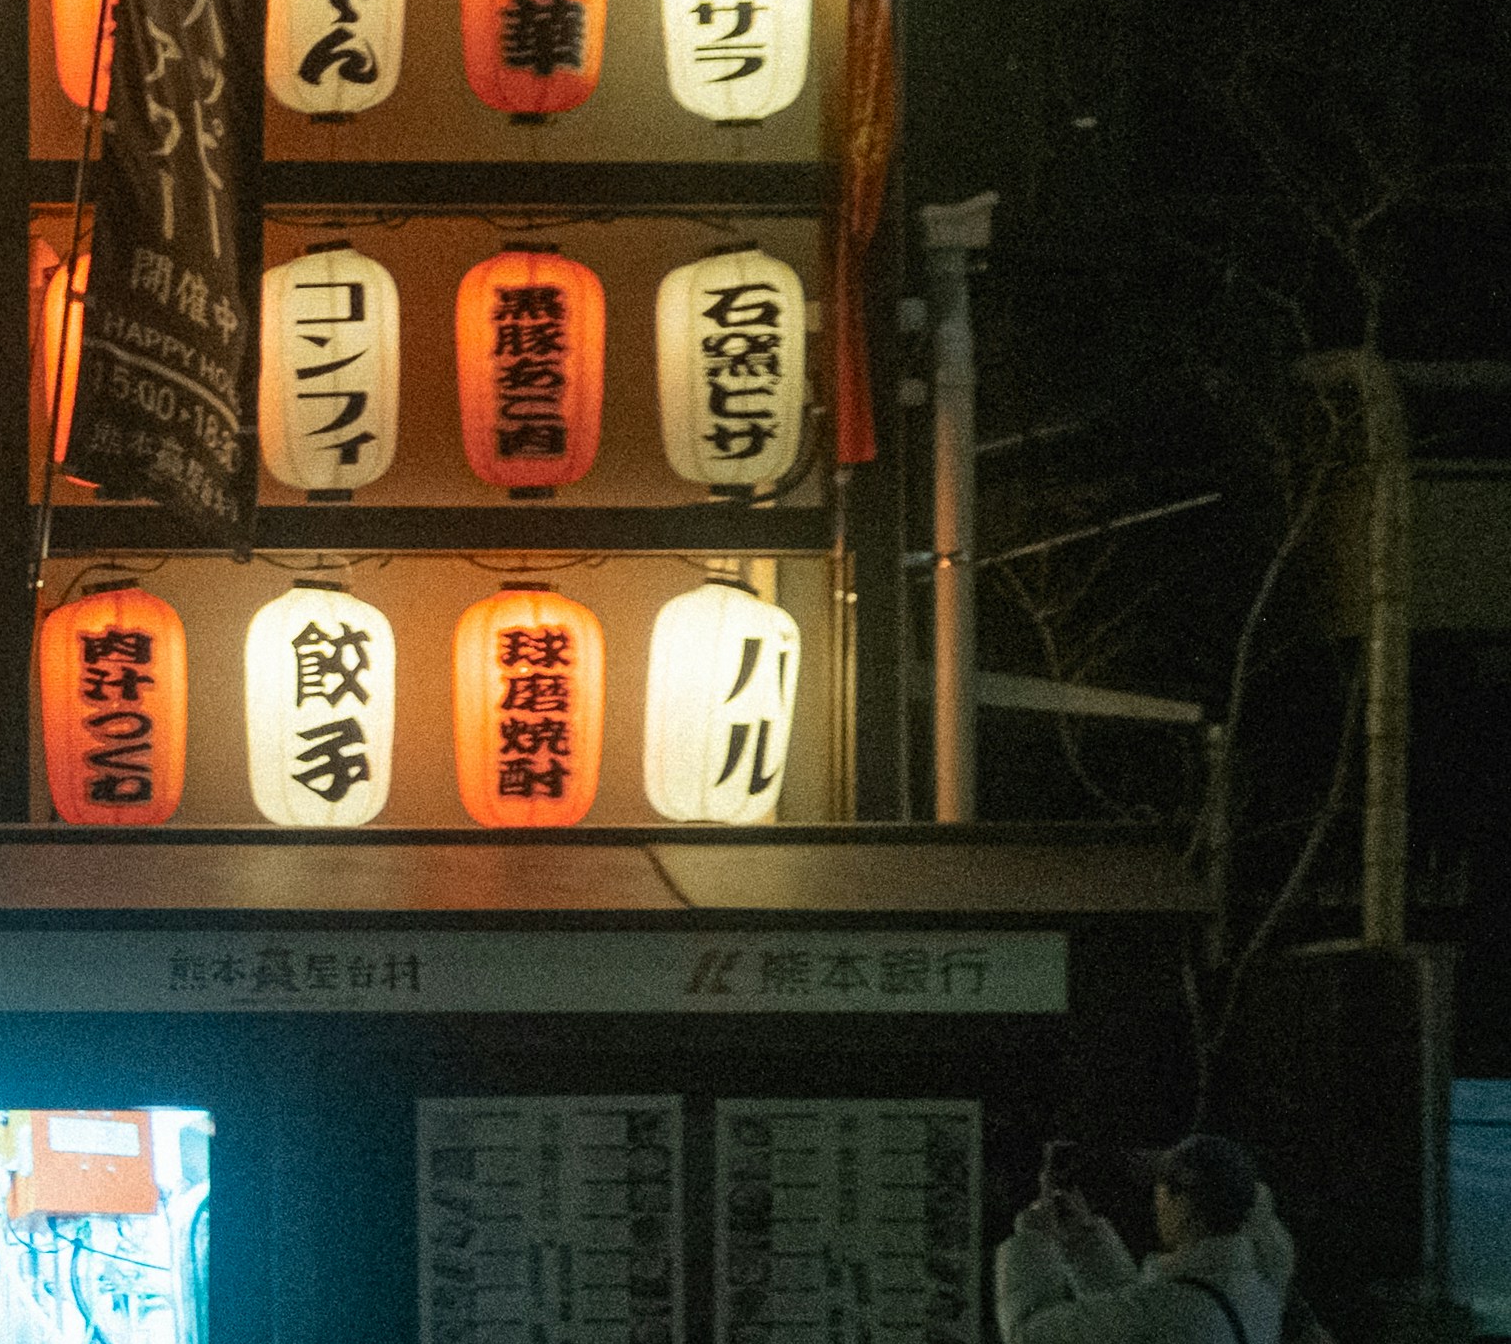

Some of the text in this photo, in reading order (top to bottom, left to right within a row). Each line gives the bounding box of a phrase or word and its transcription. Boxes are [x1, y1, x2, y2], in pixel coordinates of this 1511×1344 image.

[102, 312, 196, 368] HAPPY
[130, 246, 238, 345] 開催中
[293, 280, 377, 466] コンフィ
[78, 627, 156, 806] 肉汁つくね
[290, 621, 372, 804] 餃子
[496, 626, 575, 802] 球磨焼酎
[759, 947, 991, 996] 熊本銀行
